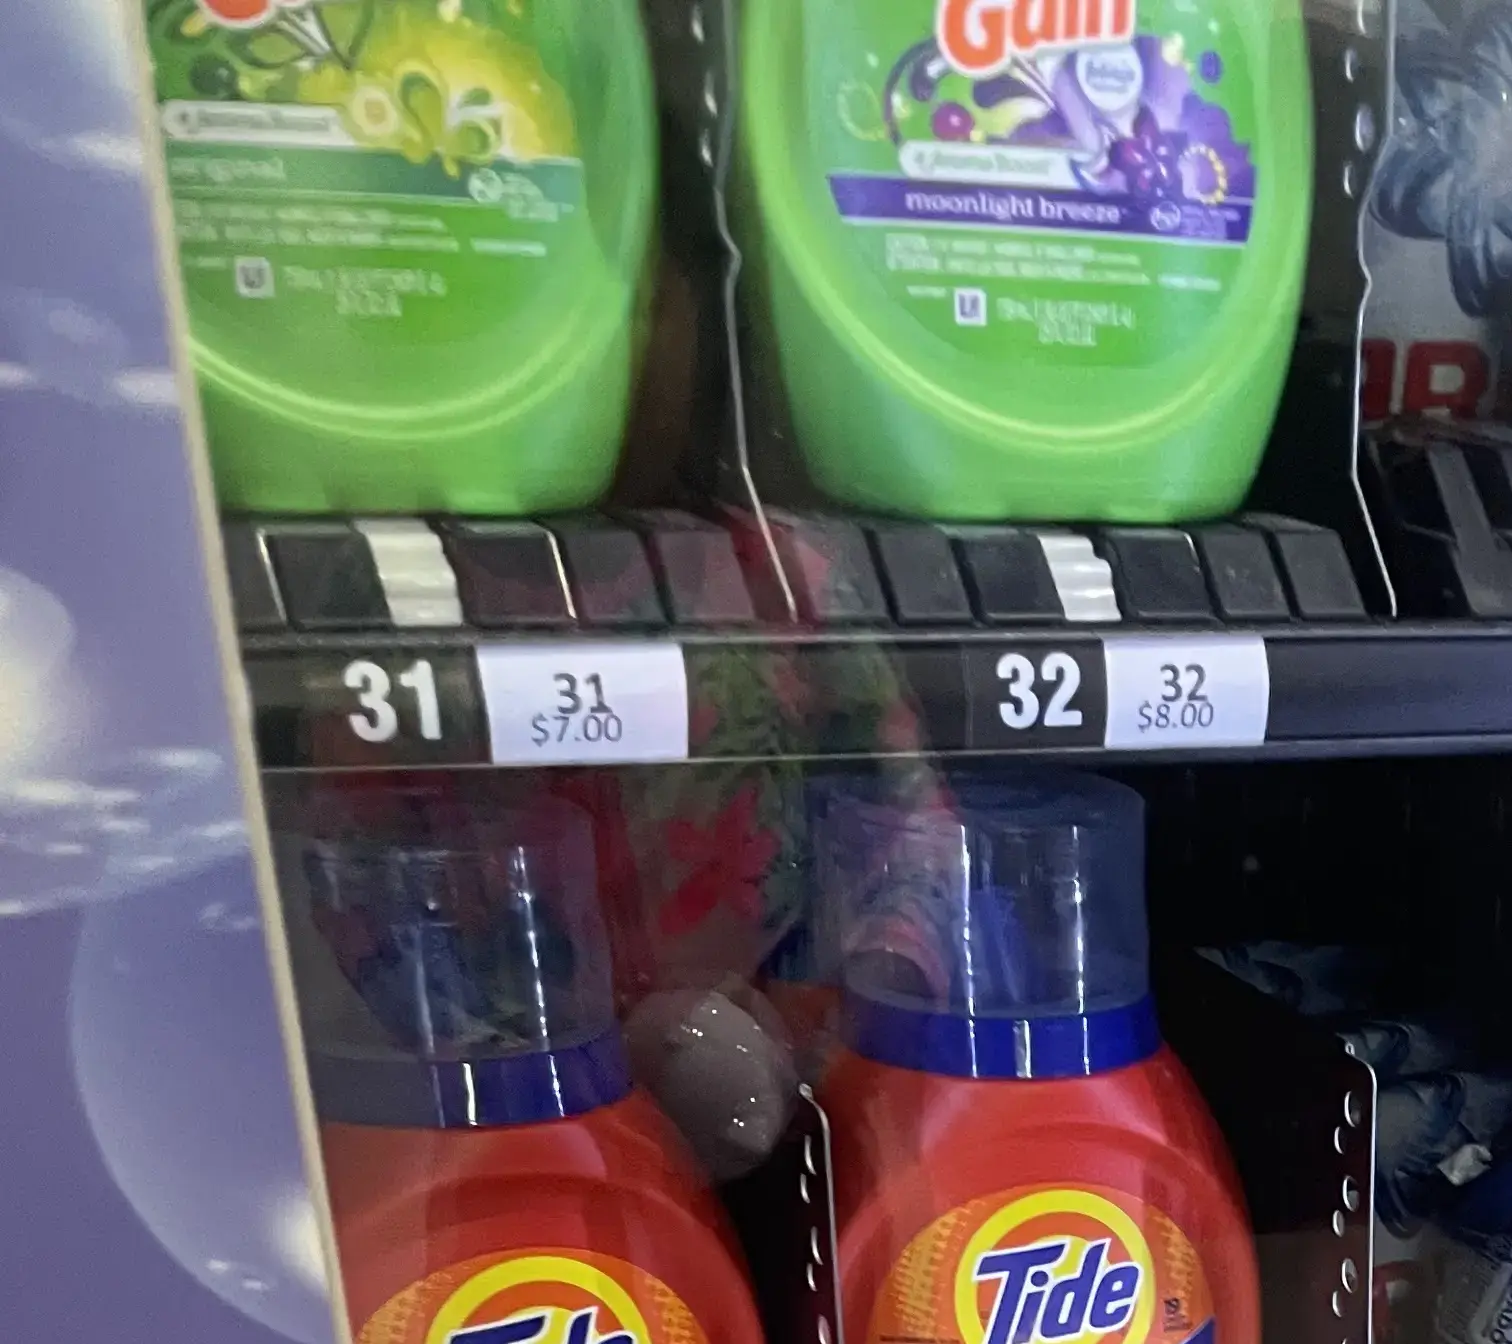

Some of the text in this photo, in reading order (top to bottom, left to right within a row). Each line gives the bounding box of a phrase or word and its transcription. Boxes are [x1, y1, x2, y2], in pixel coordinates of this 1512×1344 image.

[905, 191, 1034, 220] moonlight
[1040, 198, 1121, 225] breeze
[343, 659, 441, 742] 31
[552, 673, 612, 715] 31
[996, 652, 1082, 729] 32
[1160, 664, 1209, 703] 32
[531, 714, 623, 746] $7.00
[1138, 701, 1214, 733] $8.00
